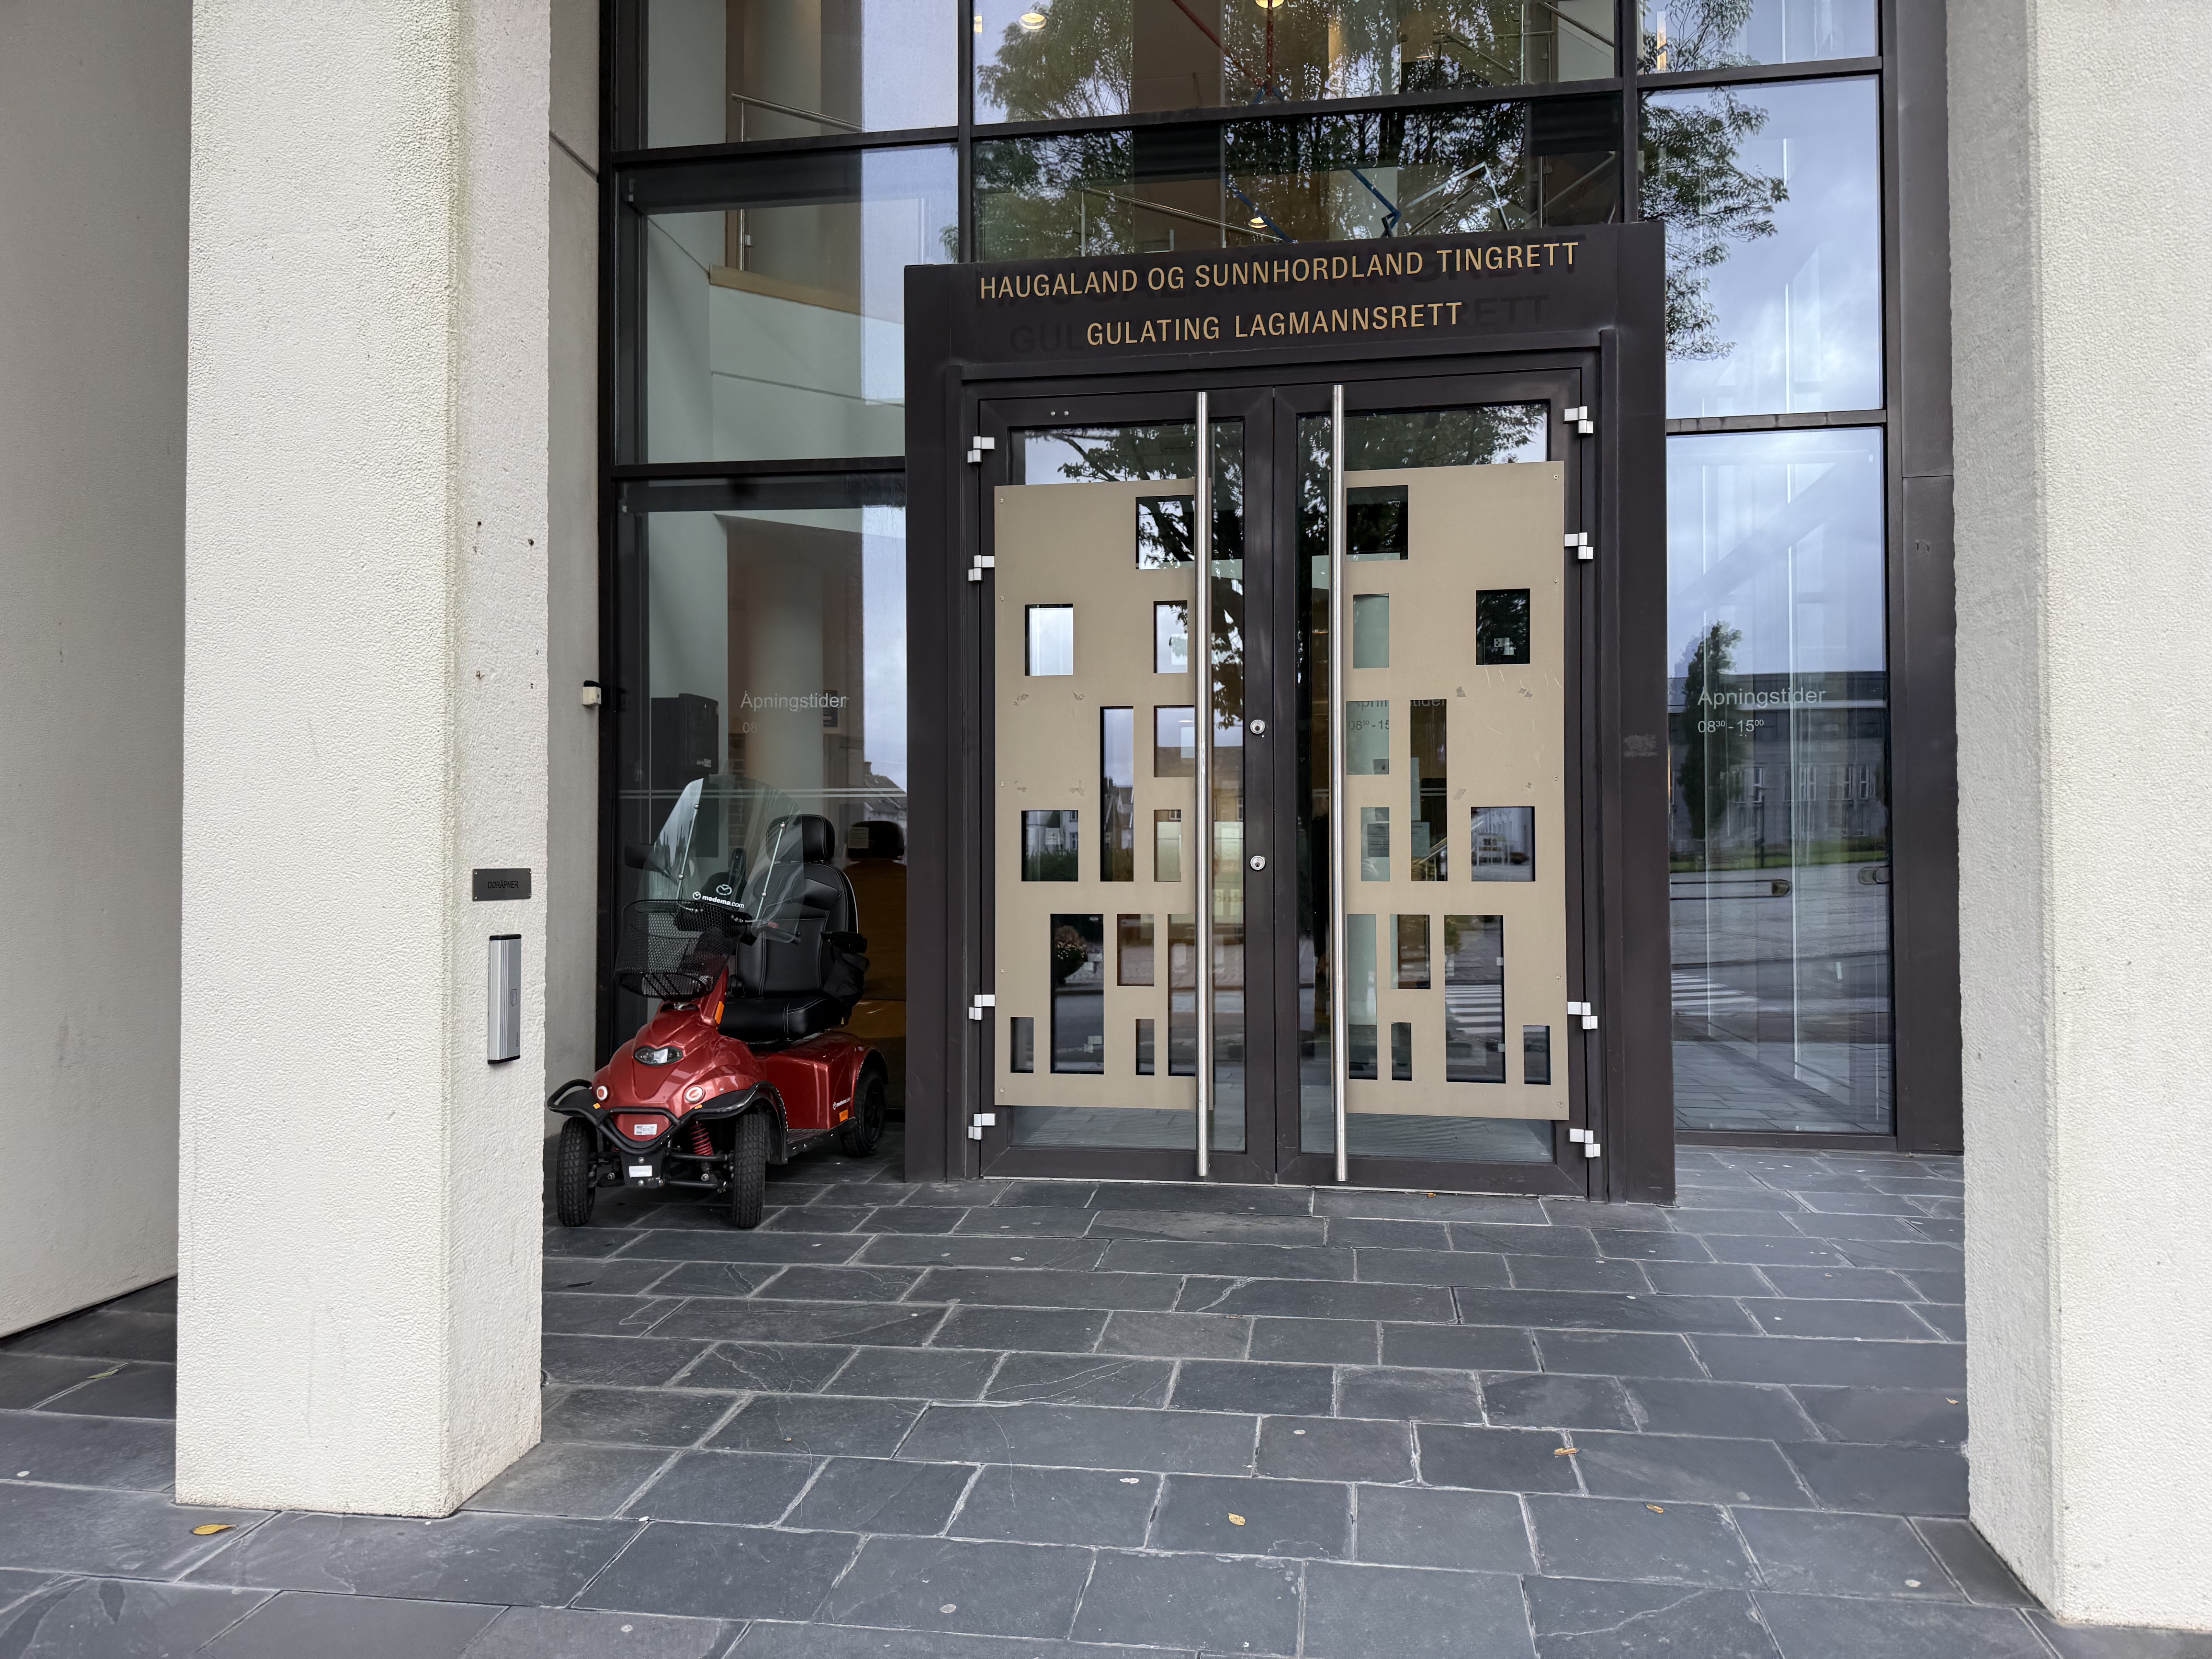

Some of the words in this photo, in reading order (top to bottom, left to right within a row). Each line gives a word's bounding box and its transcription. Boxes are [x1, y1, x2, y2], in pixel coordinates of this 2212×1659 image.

[981, 270, 1137, 299] HAUGALAND
[1148, 266, 1184, 290] OG
[1195, 252, 1423, 287] SUNNHORDLAND
[1436, 242, 1578, 272] TINGRETT
[1087, 318, 1219, 345] GULATING
[1236, 302, 1462, 338] LAGMANNSRETT
[740, 691, 847, 712] Åpningstider
[1697, 686, 1826, 709] Åpningstider
[702, 895, 745, 908] medema.com
